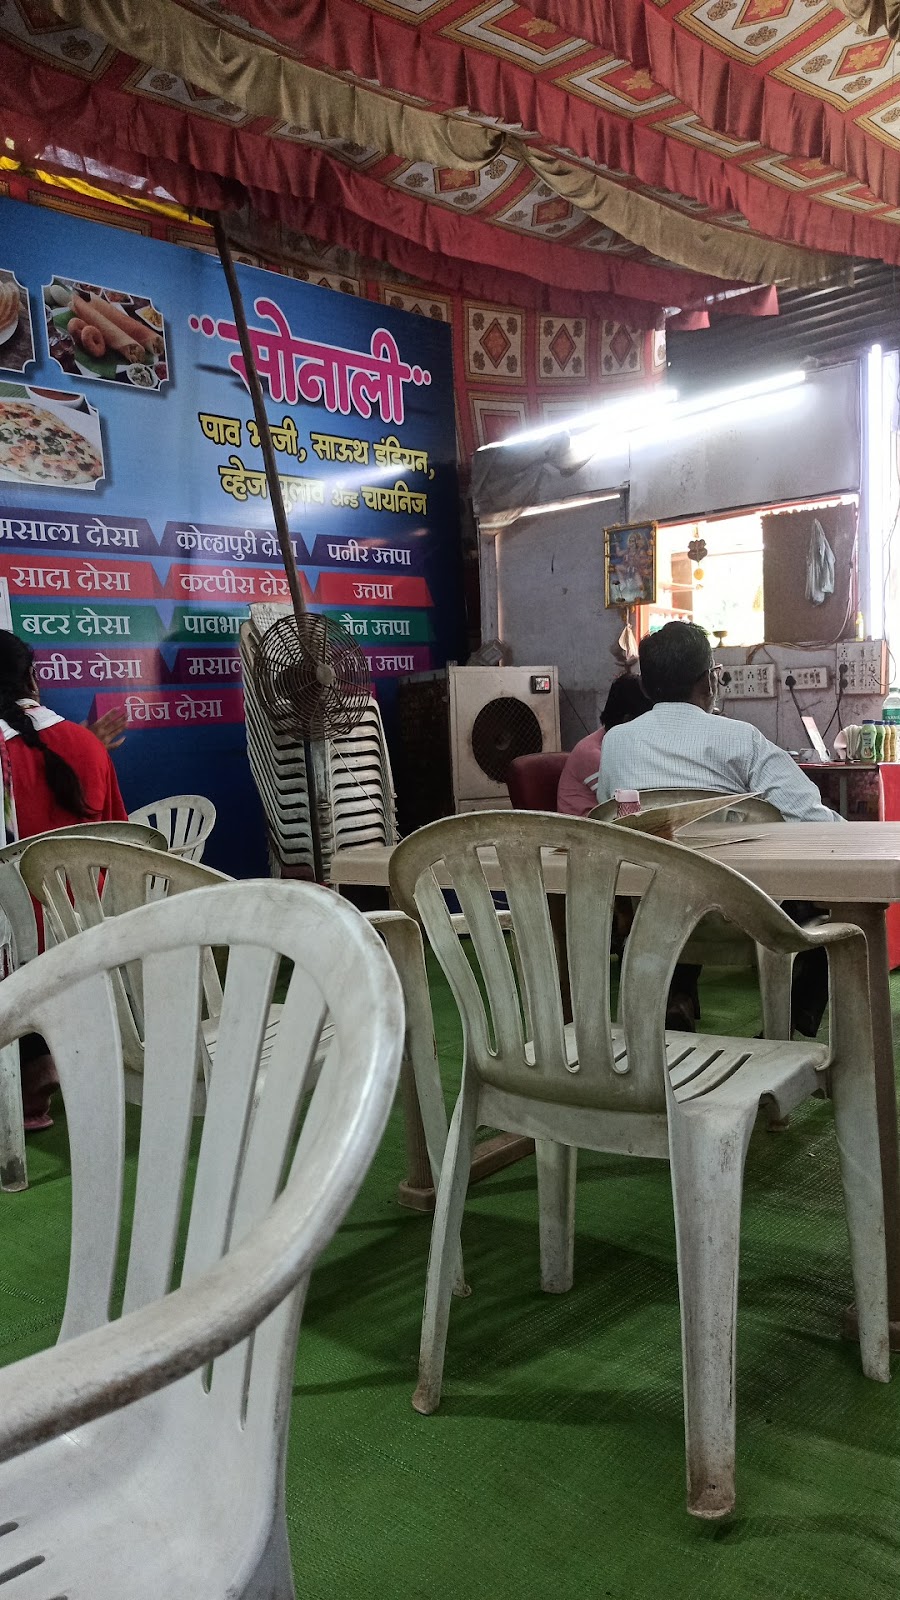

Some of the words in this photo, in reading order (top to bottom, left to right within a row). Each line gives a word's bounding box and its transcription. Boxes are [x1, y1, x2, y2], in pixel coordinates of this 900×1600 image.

[217, 297, 411, 424] सोनाली
[199, 412, 241, 446] पाव
[247, 417, 307, 462] भजी,
[311, 431, 368, 465] साऊथ
[373, 436, 435, 480] इंडियन,
[218, 455, 267, 500] व्हेज
[361, 480, 427, 515] चायनिज
[0, 518, 80, 544] मसाला
[84, 518, 139, 547] दोसा
[175, 525, 258, 560] कोल्हापुरी
[327, 539, 368, 563] पनीर
[372, 547, 411, 565] उत्तपा
[10, 567, 71, 590] सादा
[76, 562, 131, 591] दोसा
[179, 569, 255, 595] कटपीस
[259, 571, 292, 596] दोस
[352, 583, 393, 600] उत्तपा
[20, 614, 70, 635] बटर
[75, 608, 130, 636] दोसा
[339, 613, 368, 635] जैन
[371, 620, 410, 636] उत्तपा
[32, 653, 83, 680] नीर
[88, 653, 142, 681] दोसा
[376, 656, 414, 671] उत्तपा
[125, 696, 170, 722] चिज
[175, 694, 223, 721] दोसा
